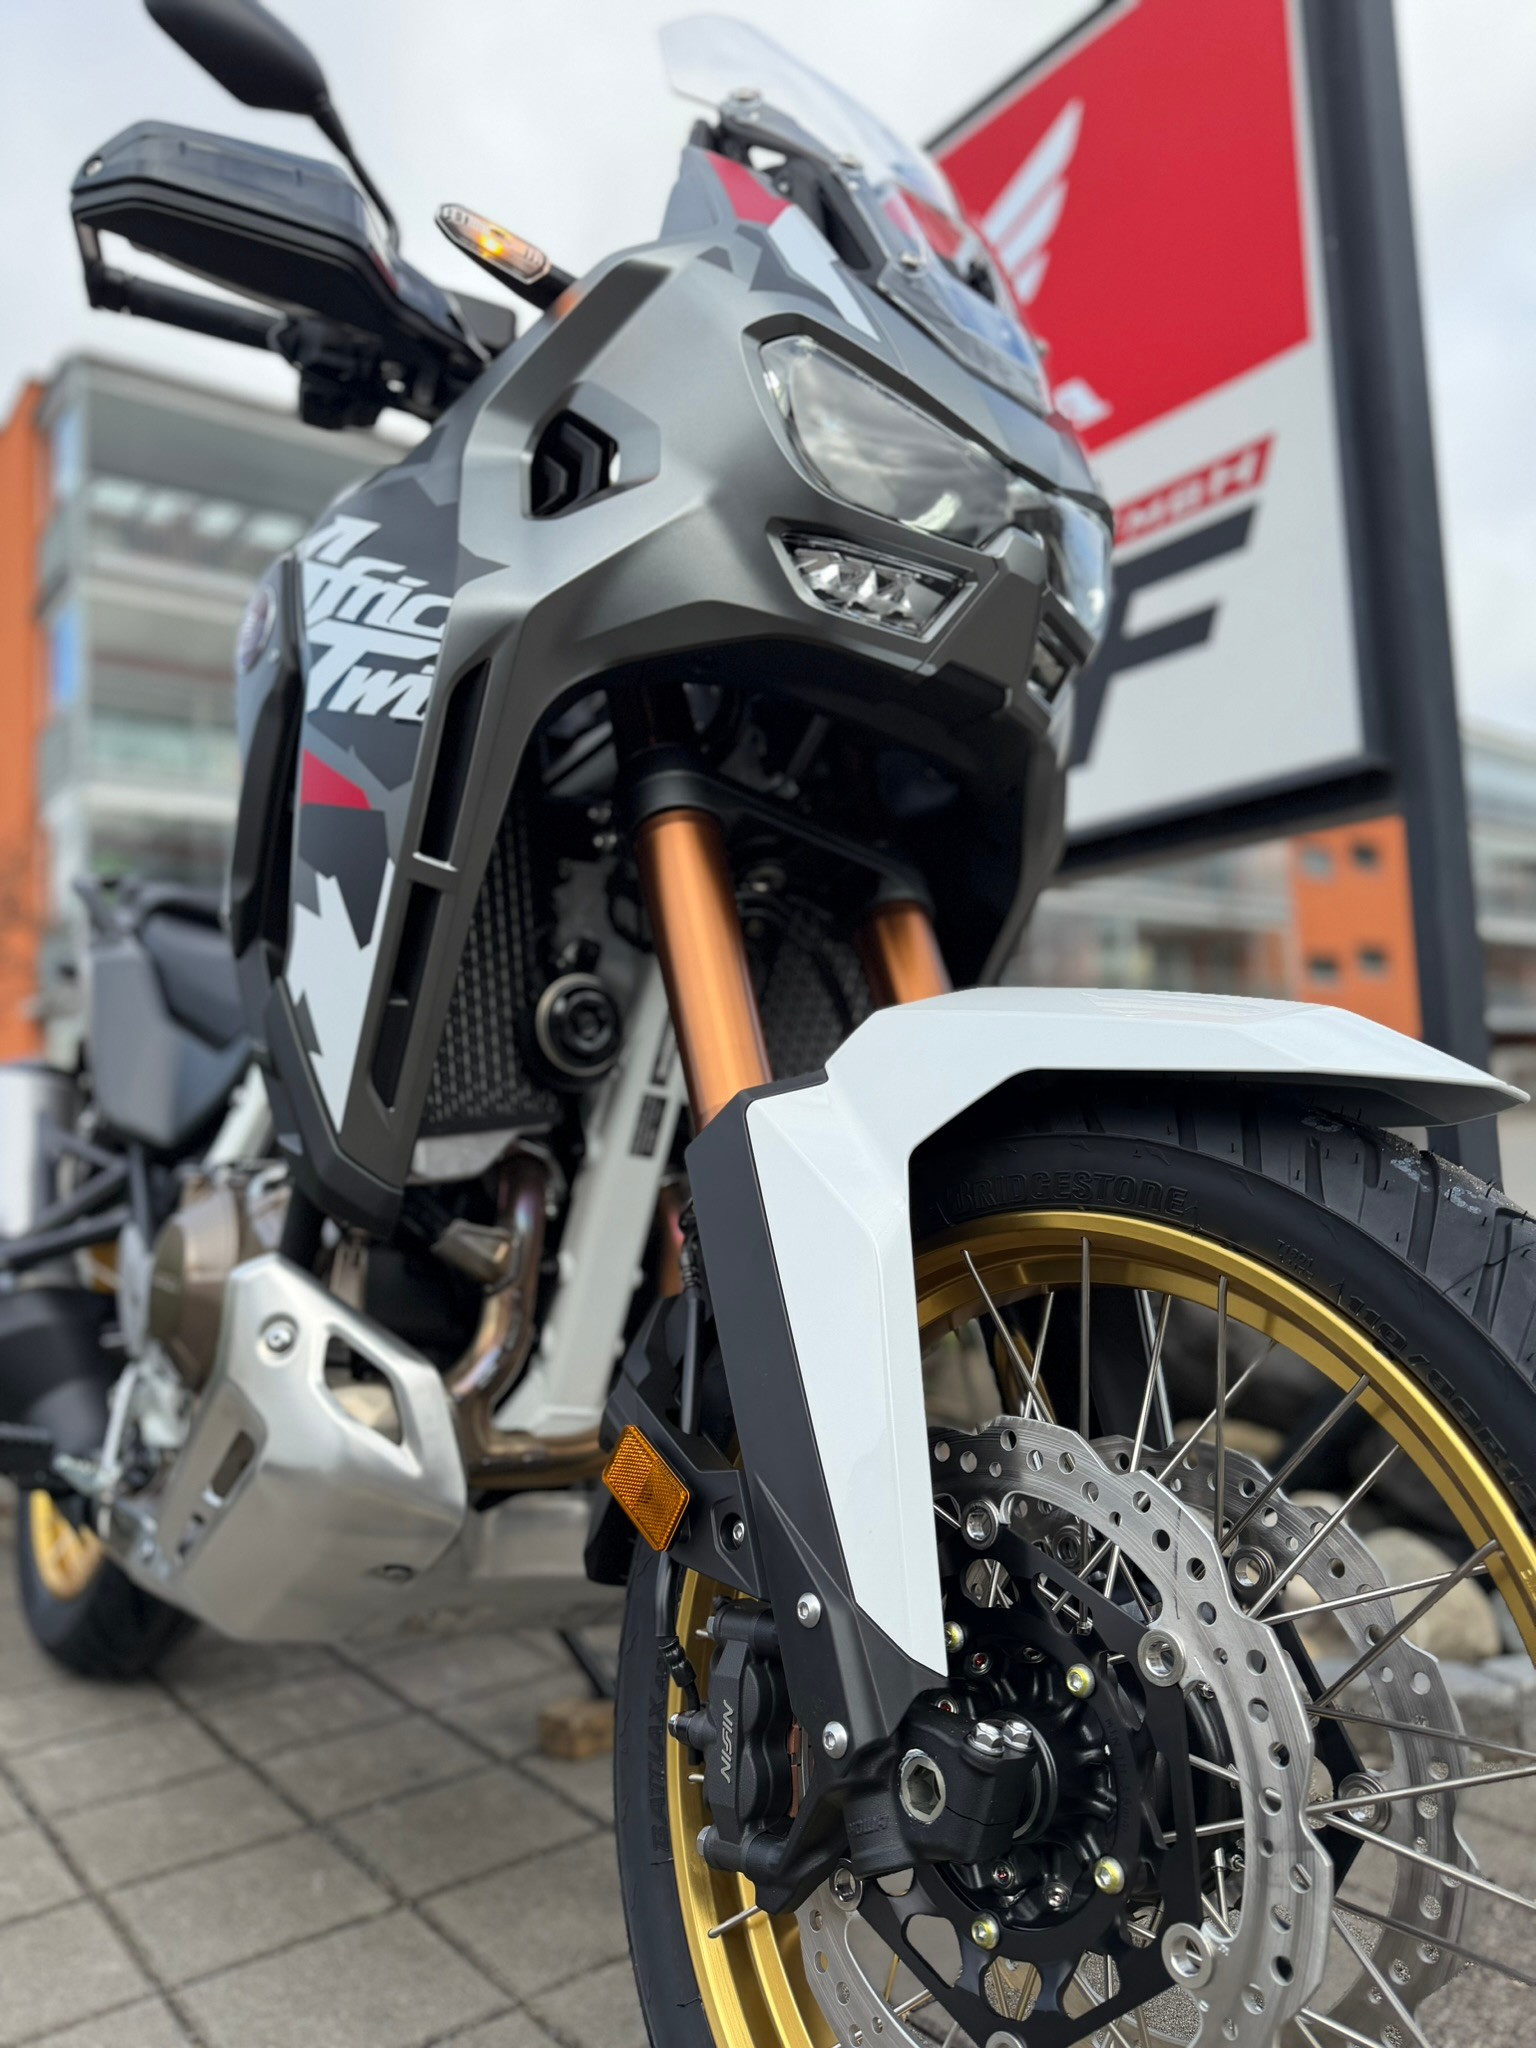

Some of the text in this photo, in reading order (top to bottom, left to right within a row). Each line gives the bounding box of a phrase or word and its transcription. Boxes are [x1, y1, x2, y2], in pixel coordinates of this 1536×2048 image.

[299, 514, 455, 640] Afric
[305, 617, 443, 722] Twi
[945, 1169, 1190, 1218] BRIDGESTONE
[720, 1699, 734, 1784] NISSIN
